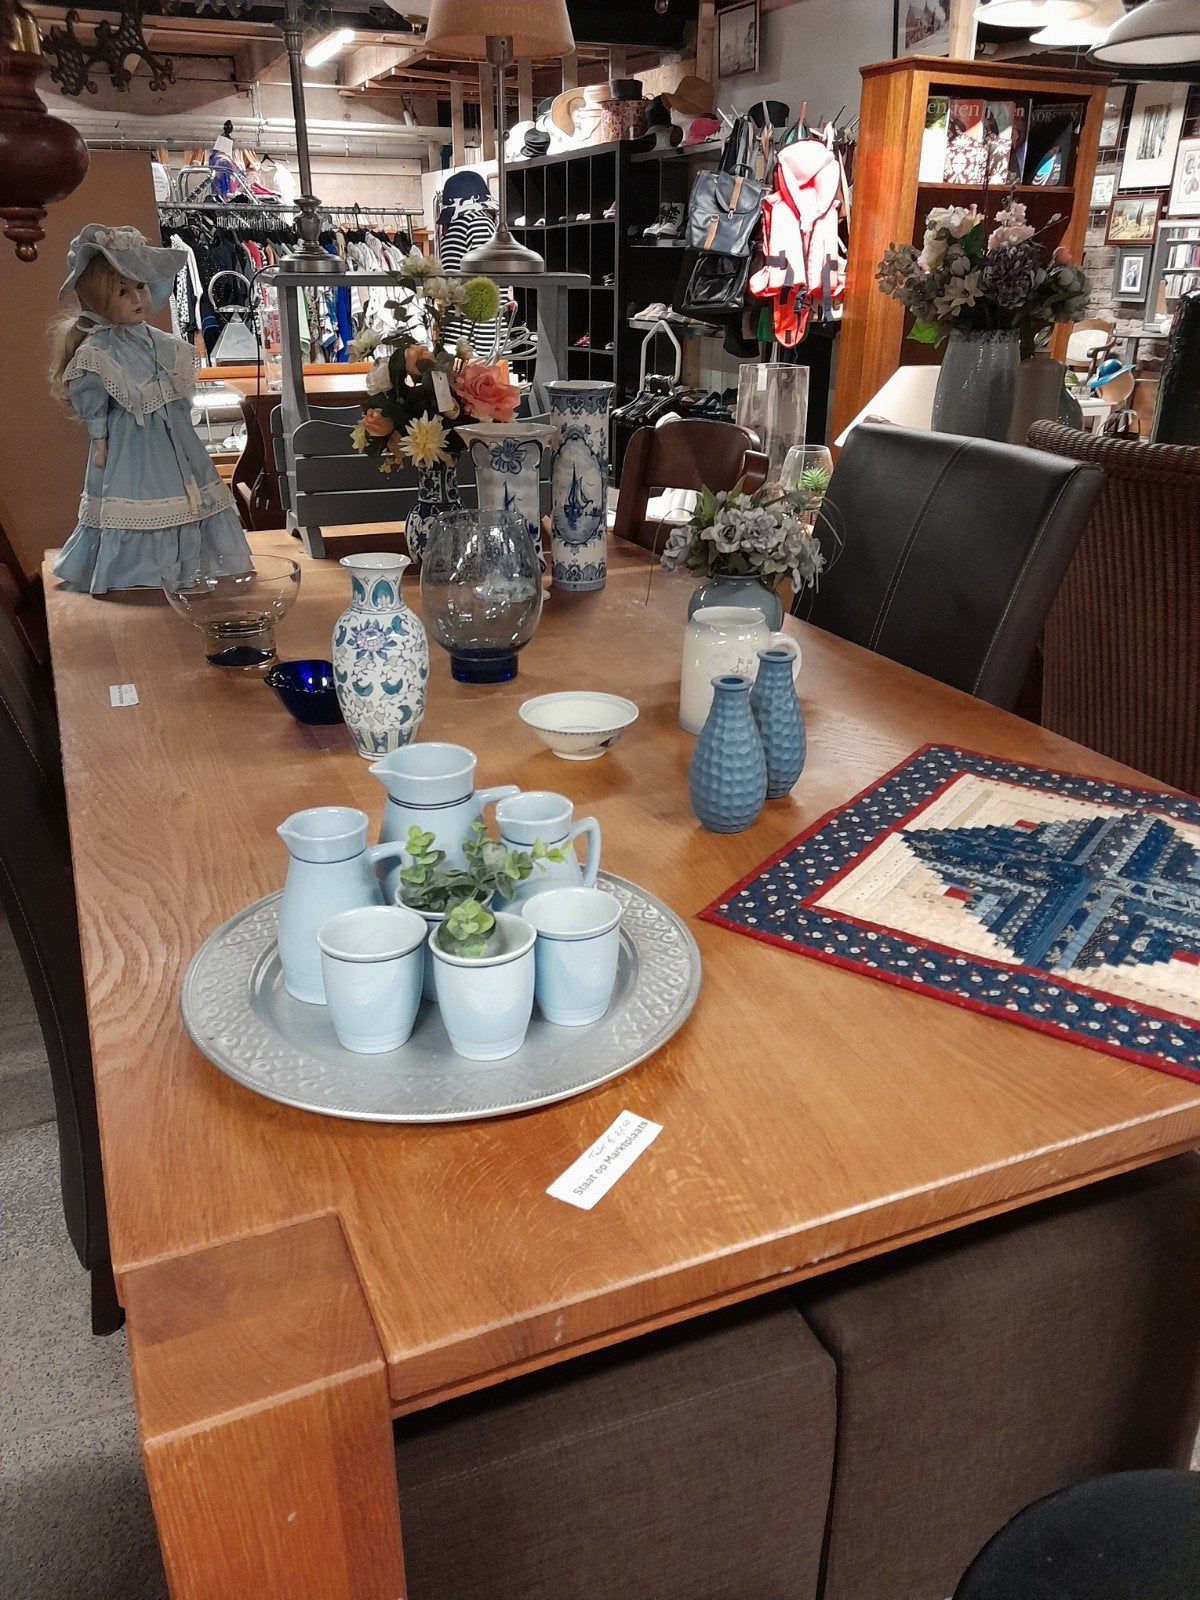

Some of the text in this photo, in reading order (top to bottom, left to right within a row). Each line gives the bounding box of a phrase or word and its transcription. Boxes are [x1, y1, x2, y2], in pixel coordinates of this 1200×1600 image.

[573, 1120, 648, 1196] Staat op Marktplaats
